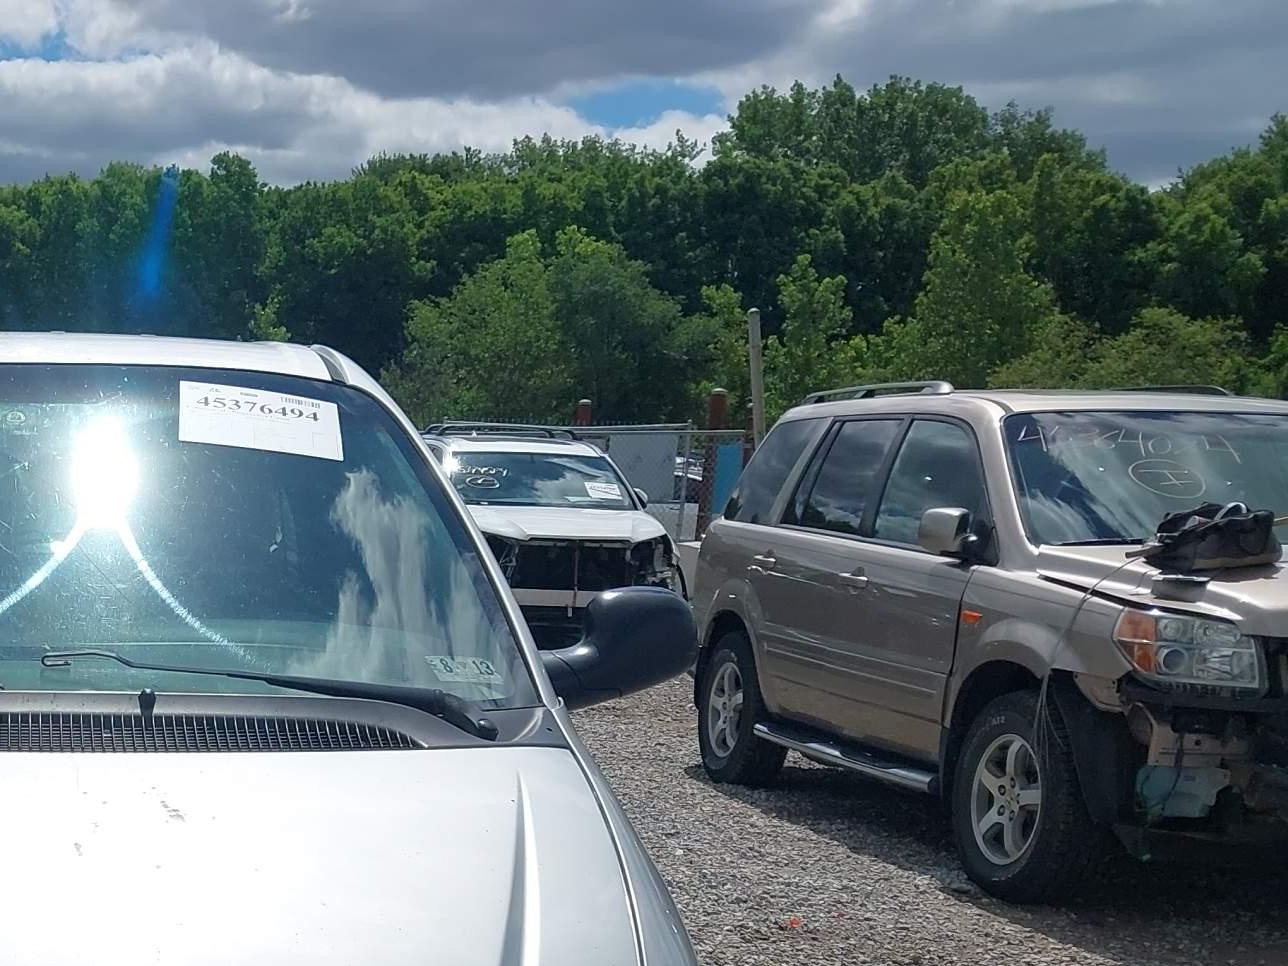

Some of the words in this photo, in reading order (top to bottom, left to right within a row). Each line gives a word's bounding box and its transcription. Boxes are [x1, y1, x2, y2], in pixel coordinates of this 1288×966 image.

[196, 395, 320, 422] 45376494
[439, 657, 454, 673] 8
[471, 660, 494, 676] 13
